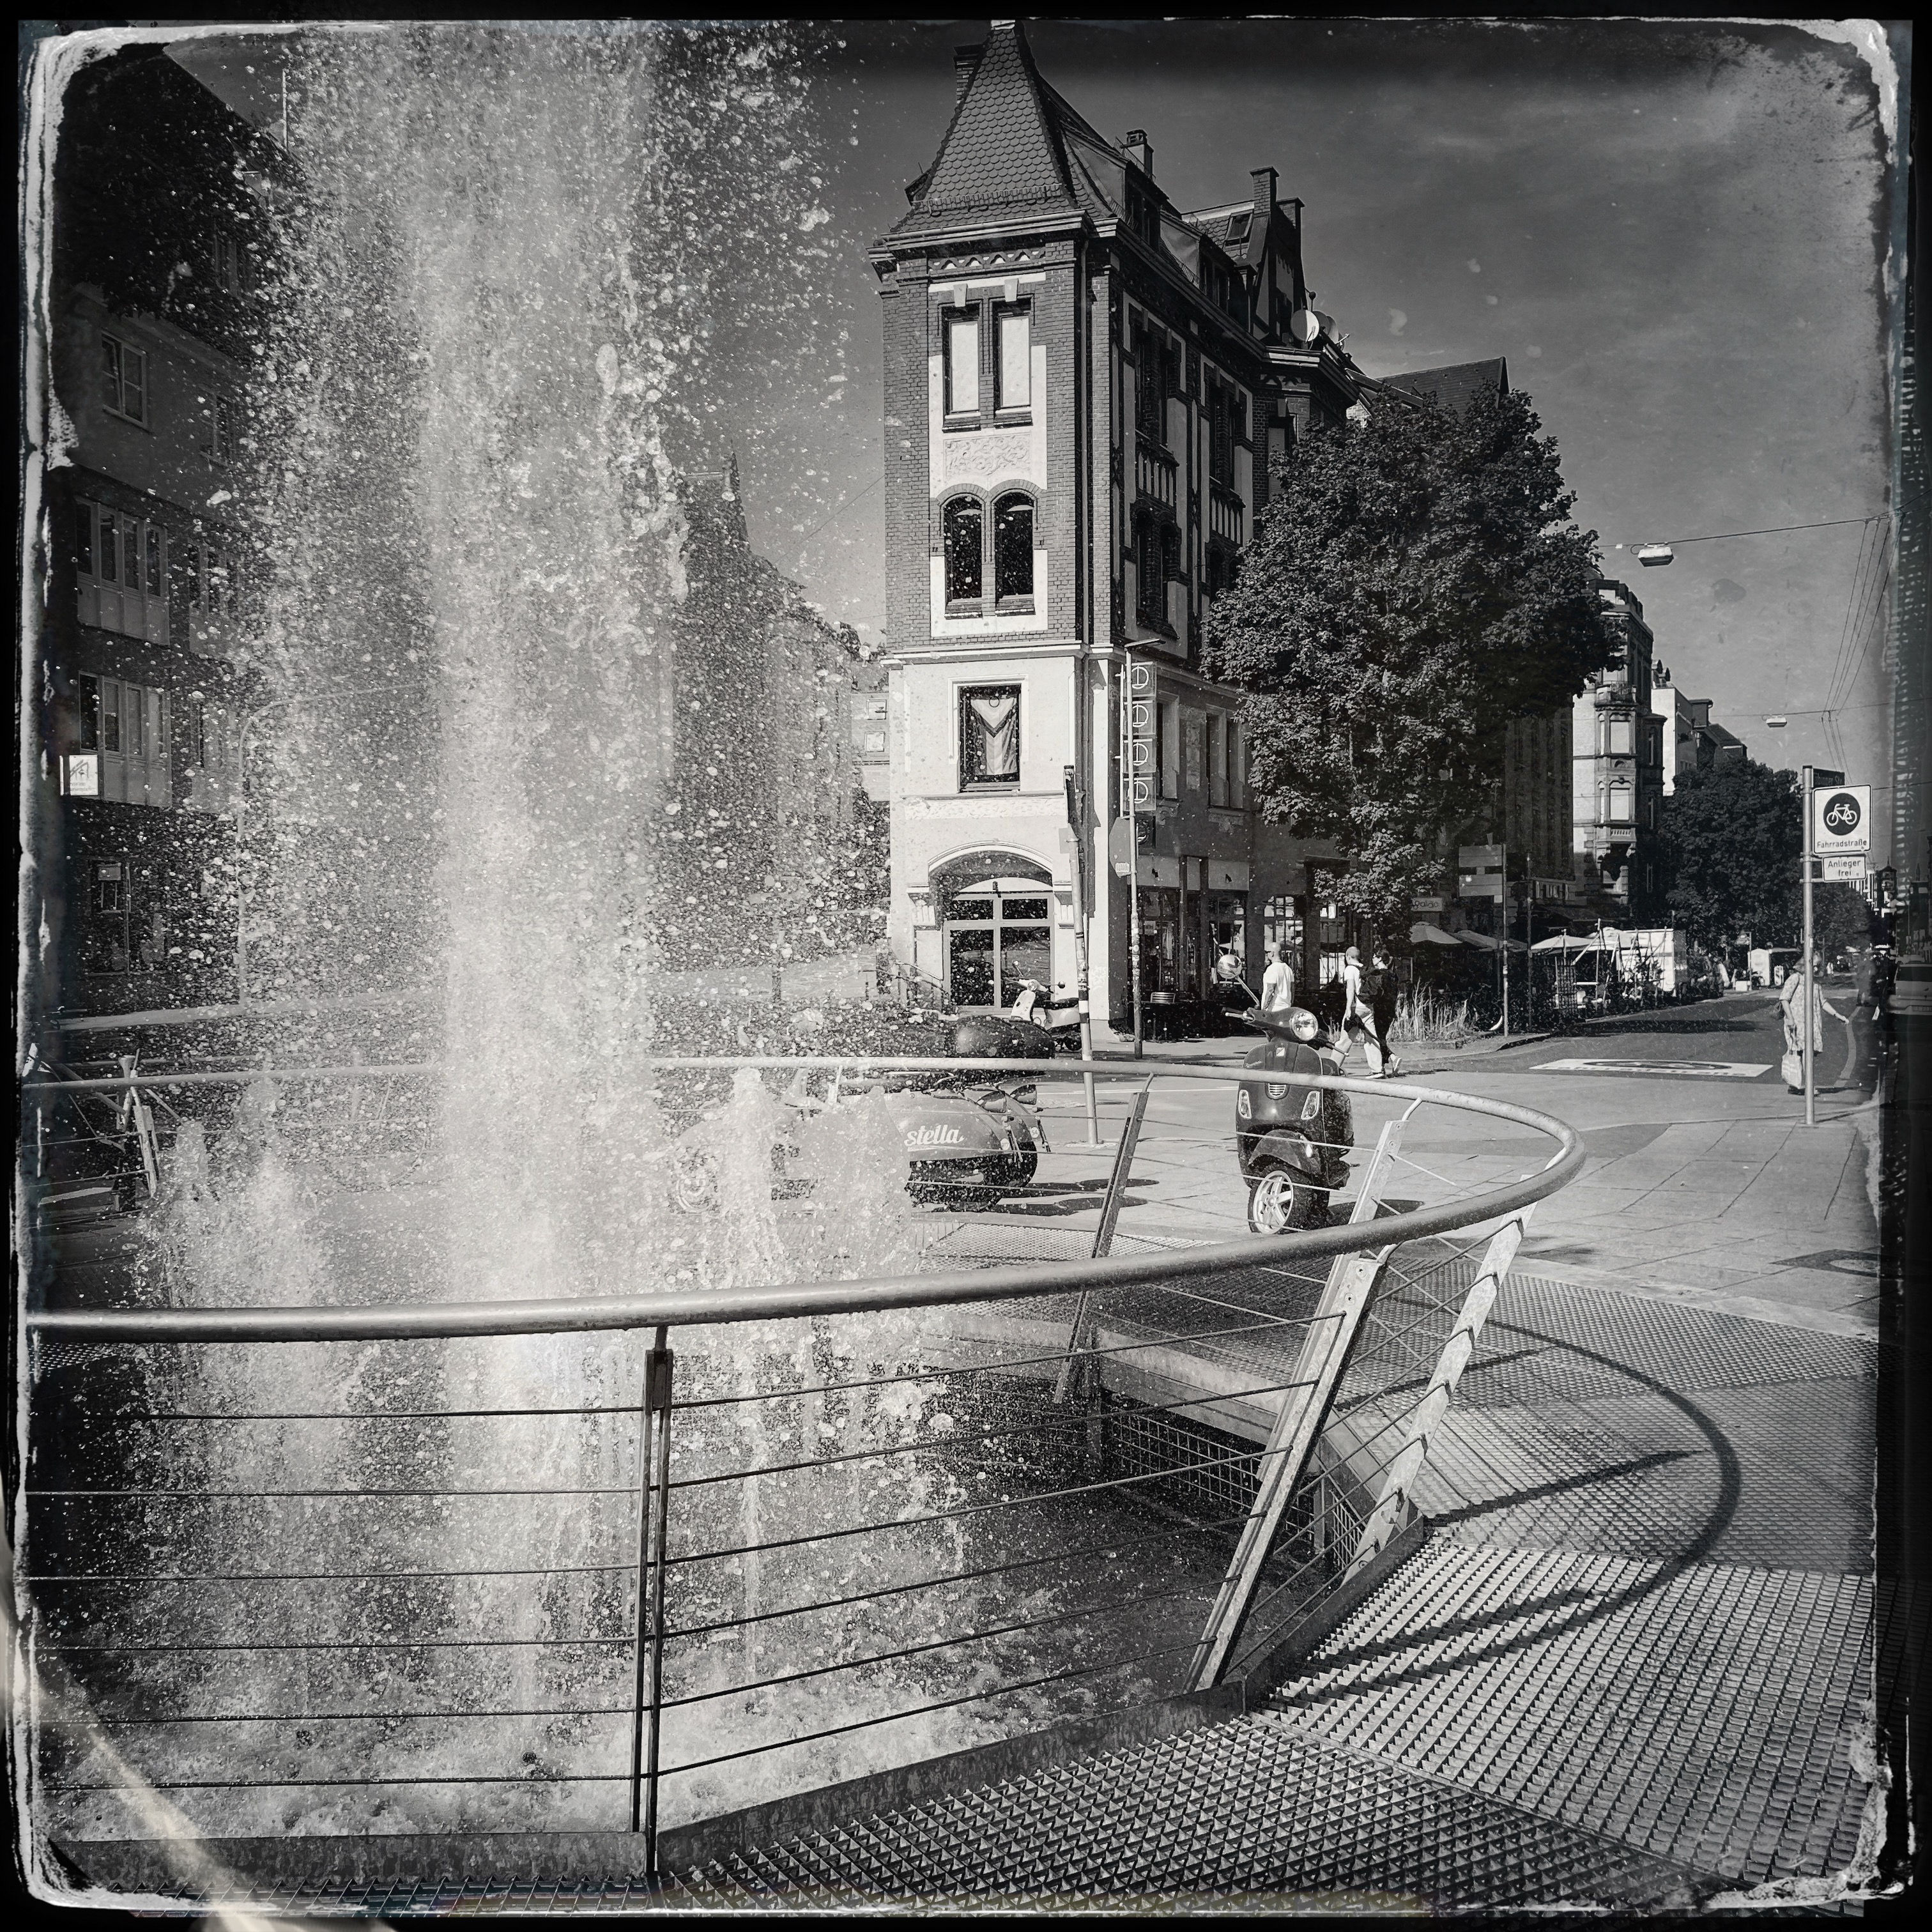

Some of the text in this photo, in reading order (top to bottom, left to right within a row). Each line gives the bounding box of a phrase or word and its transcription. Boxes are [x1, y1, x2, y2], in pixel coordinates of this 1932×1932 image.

[1817, 839, 1867, 850] Fahrradstraße
[1828, 860, 1861, 869] Anlieger
[904, 1124, 964, 1146] stella
